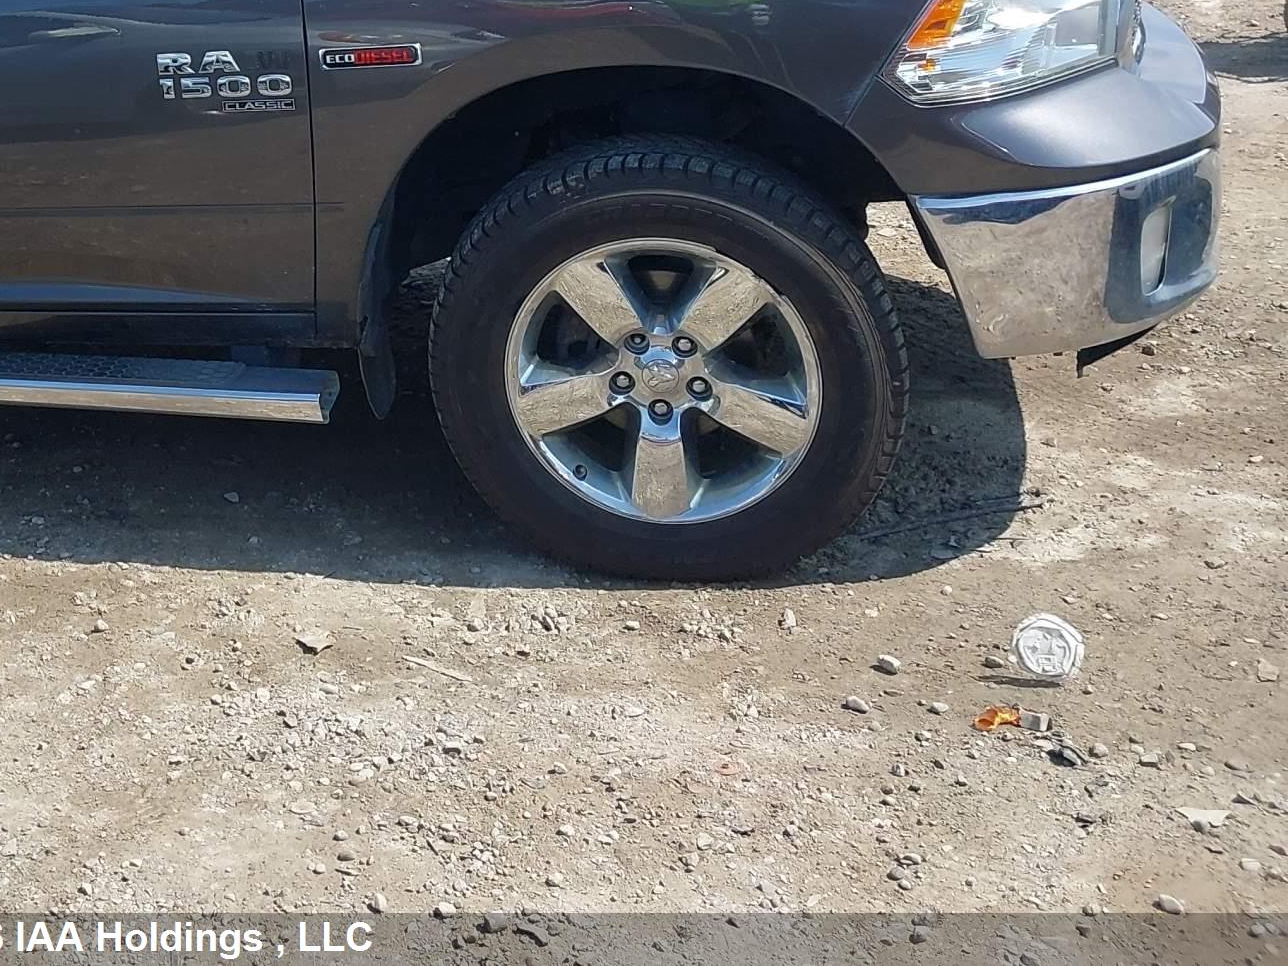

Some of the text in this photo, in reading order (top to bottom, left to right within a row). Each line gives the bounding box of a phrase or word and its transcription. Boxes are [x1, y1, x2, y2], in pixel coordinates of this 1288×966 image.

[326, 48, 414, 64] ECODIESEL
[159, 74, 293, 99] 1500
[224, 100, 295, 111] CLASSIC
